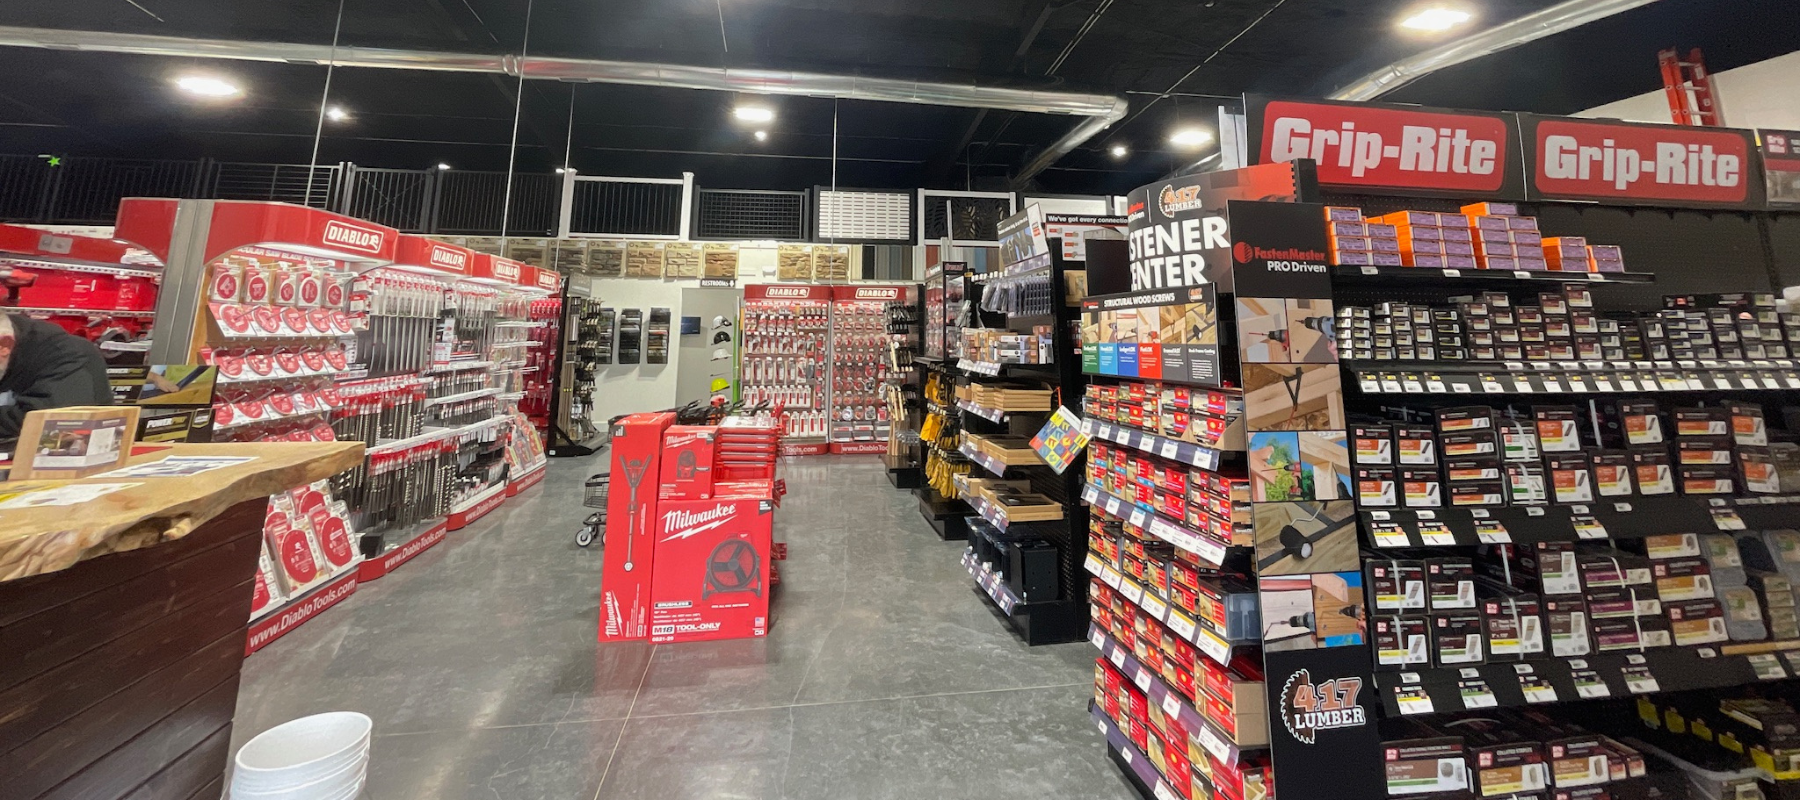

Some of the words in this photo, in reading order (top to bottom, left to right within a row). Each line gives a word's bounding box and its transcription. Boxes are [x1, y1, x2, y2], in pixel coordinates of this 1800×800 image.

[1271, 117, 1496, 177] Grip-Rite
[1545, 135, 1739, 190] Grip-Rite
[1164, 186, 1199, 203] 417
[1165, 200, 1202, 212] LUMBER
[1048, 214, 1067, 223] We've
[1068, 215, 1079, 223] got
[328, 227, 370, 246] DIABLO
[1129, 216, 1231, 261] STENER
[434, 249, 458, 265] DIABLO
[1254, 247, 1326, 260] FastenMaster
[1130, 253, 1209, 292] ENTER
[1267, 261, 1291, 271] PRO
[1291, 262, 1326, 273] Driven
[769, 288, 799, 296] DIABLO
[858, 289, 887, 298] DIABLO
[1103, 297, 1133, 308] STRUCTURAL
[1133, 295, 1151, 305] WOOD
[1152, 292, 1176, 304] SCREWS
[661, 503, 735, 533] Milwaukee
[385, 527, 447, 569] www.DiabloTools.com
[250, 579, 355, 647] www.DiabloTools.com
[604, 591, 618, 637] Milwaukee
[676, 623, 721, 632] TOOL-ONLY
[1293, 680, 1360, 711] 417
[1294, 708, 1364, 729] LUMBER
